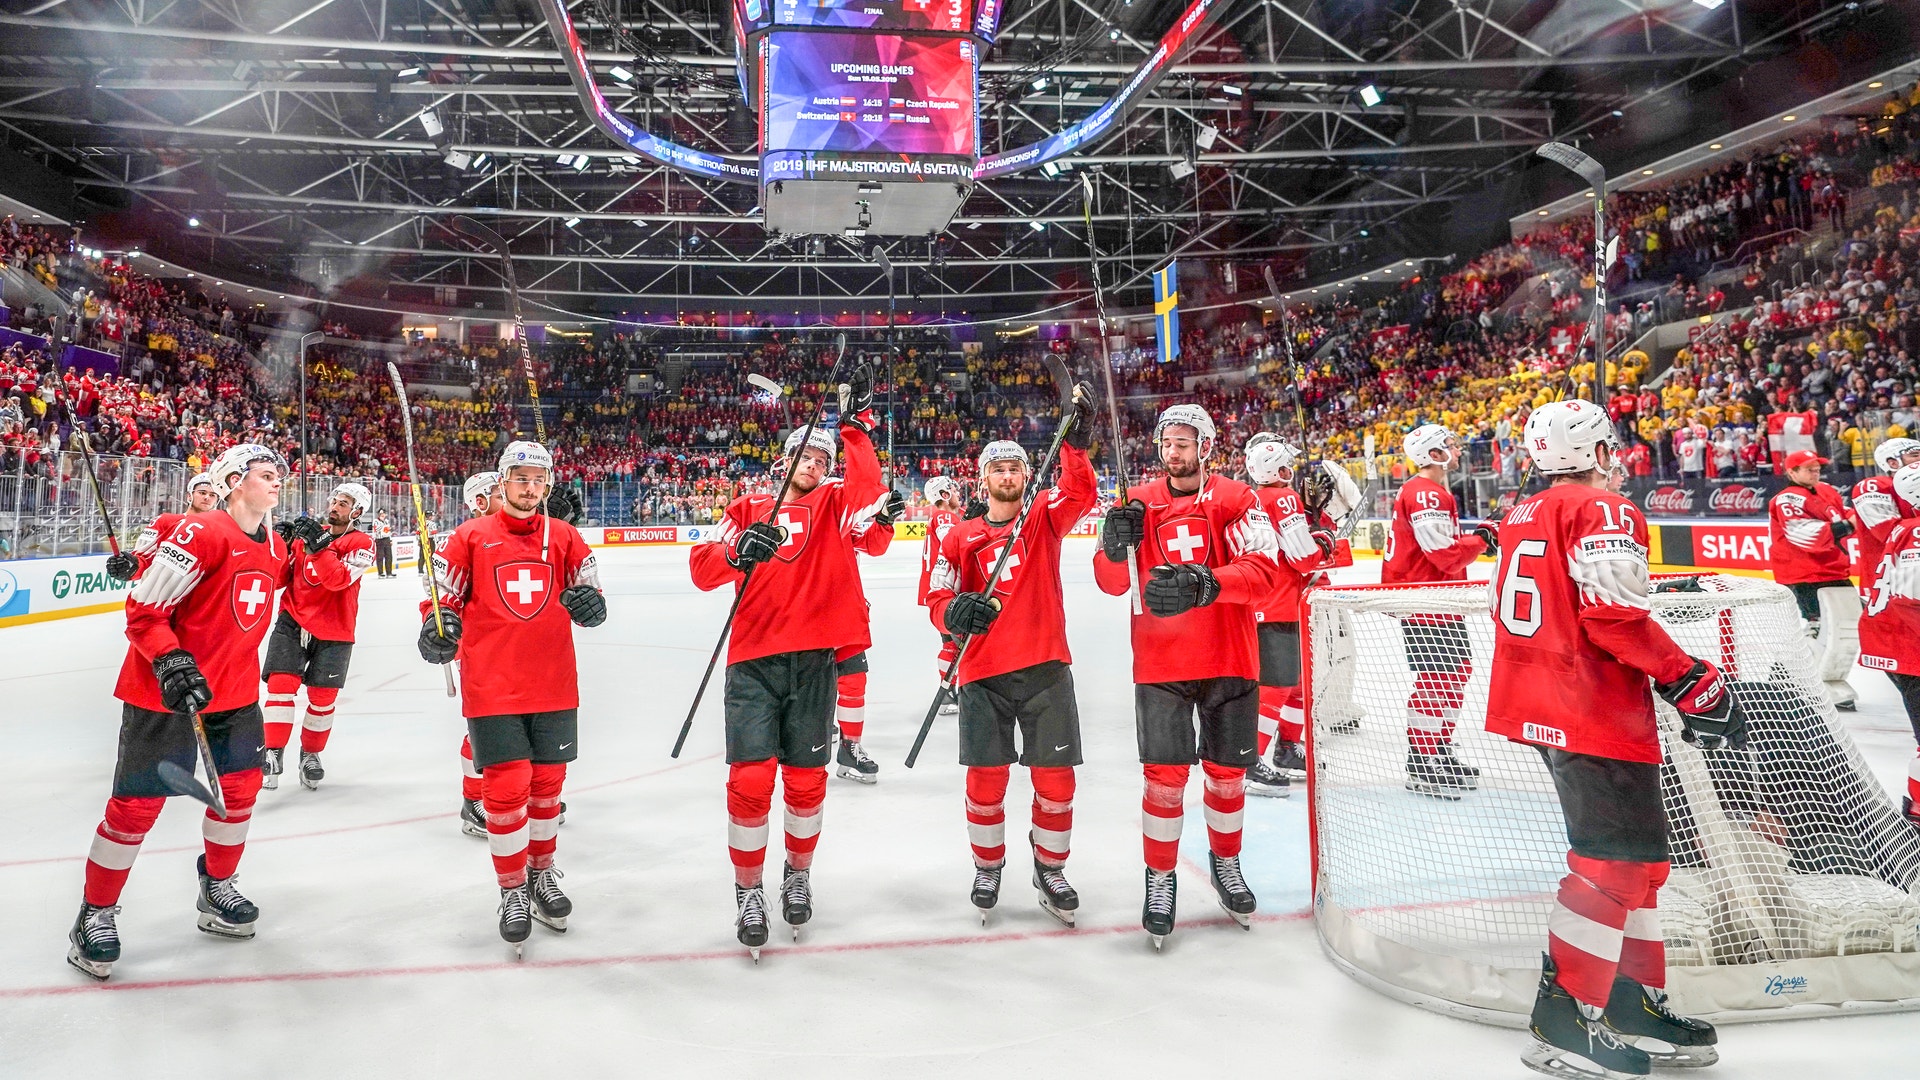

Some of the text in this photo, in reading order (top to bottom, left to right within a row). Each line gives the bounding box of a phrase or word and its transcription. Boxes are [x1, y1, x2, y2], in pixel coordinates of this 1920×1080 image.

[863, 7, 884, 15] FINAL
[831, 63, 914, 75] UPCOMING GAMES
[812, 97, 883, 107] Austria 16:15
[905, 100, 960, 110] Czech Republic
[796, 112, 883, 123] Switzerland 20:15
[905, 115, 930, 124] Russia
[653, 143, 671, 156] 2019
[740, 167, 759, 177] SVET
[986, 148, 1040, 170] CHAMPIONSHIP
[773, 159, 803, 173] 2019
[805, 160, 828, 171] IIHF
[829, 160, 922, 174] MAJSTROVSTVÁ
[923, 162, 960, 175] SVETA
[811, 435, 831, 446] ZURICH
[1533, 438, 1547, 451] 16
[528, 453, 550, 463] ZURICH
[1858, 479, 1878, 494] 76
[1277, 495, 1298, 515] 90
[1644, 489, 1695, 511] Coca-Cola
[1708, 487, 1766, 510] Coca-Cola
[936, 513, 952, 525] 64
[1506, 499, 1543, 525] DIAZ
[1595, 501, 1635, 536] 16
[169, 519, 203, 545] 15
[623, 529, 674, 541] KRUŠOVICE
[160, 545, 194, 567] SSOT
[1869, 657, 1895, 669] IIHF
[1536, 726, 1562, 744] IIHF
